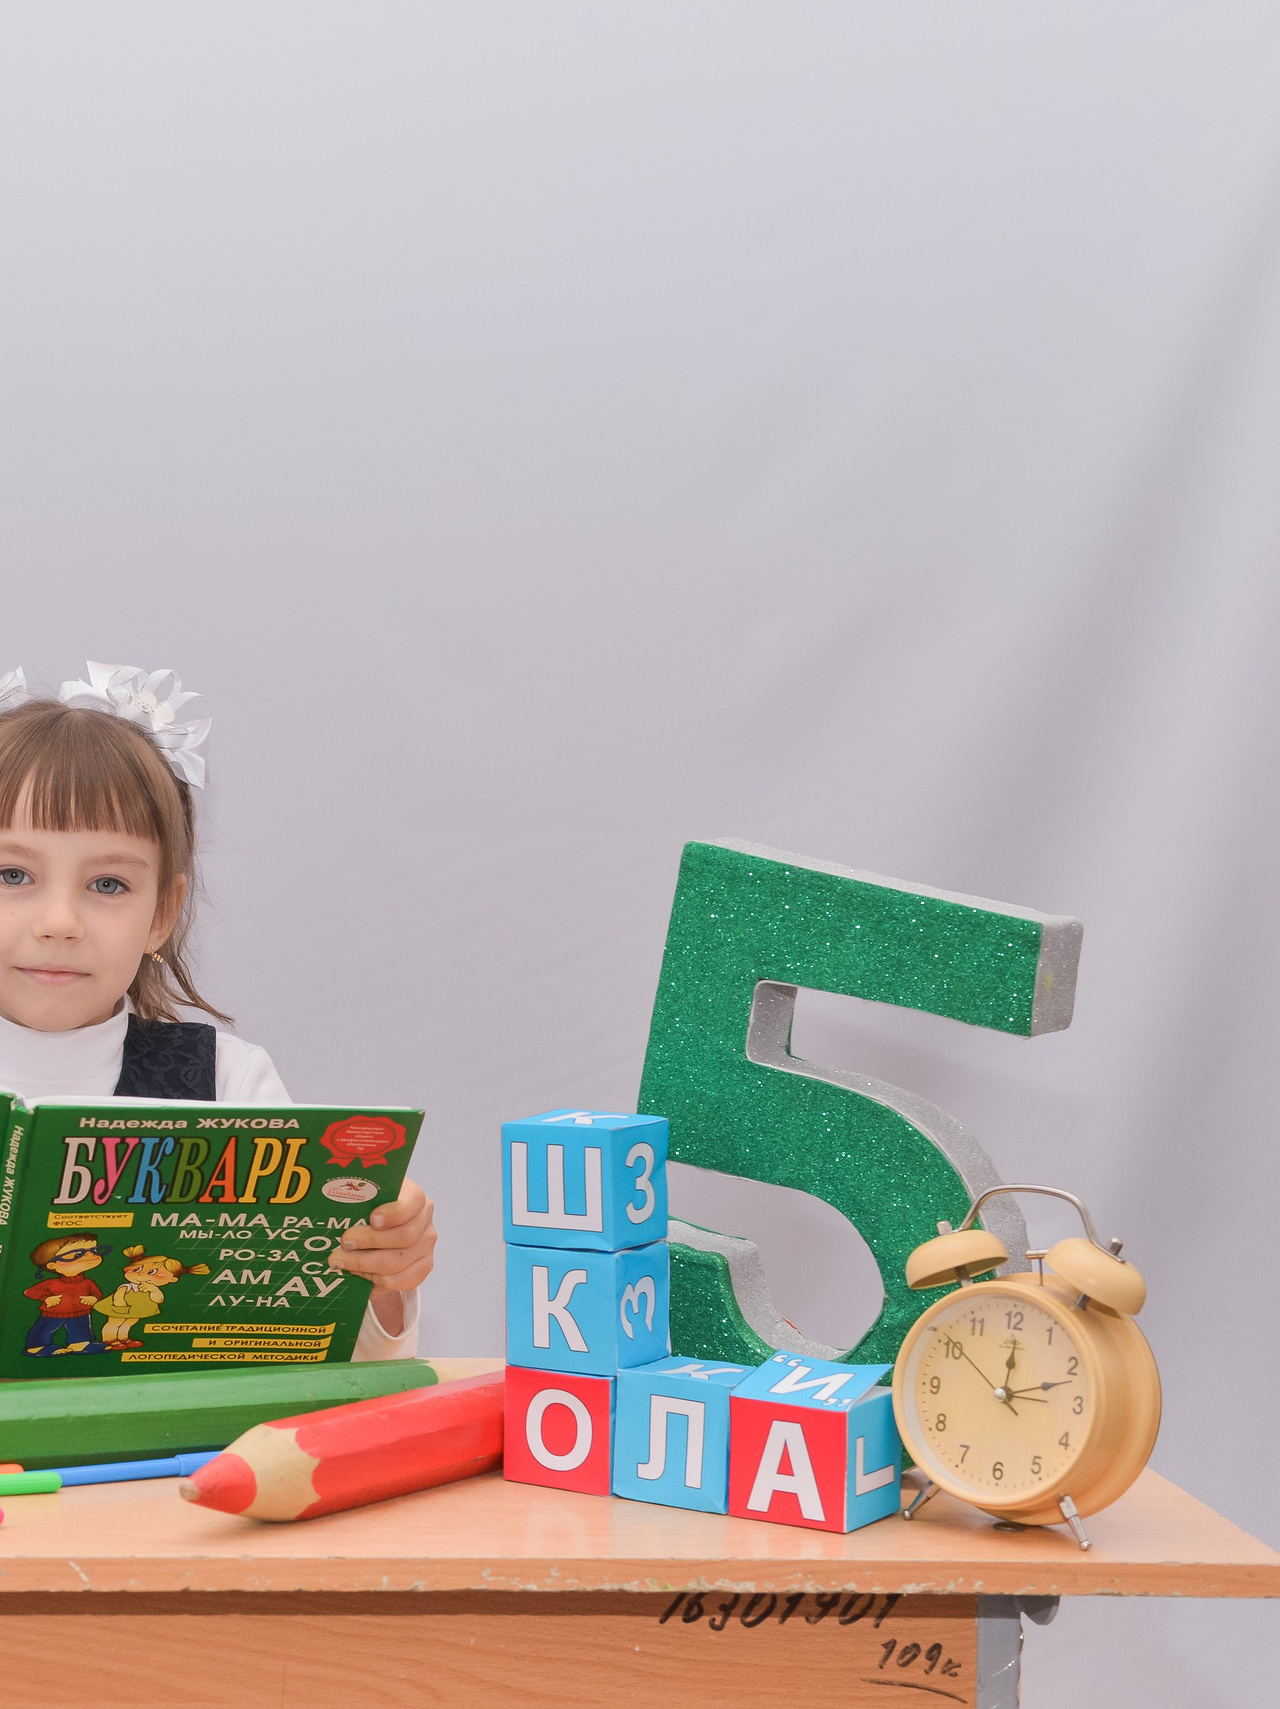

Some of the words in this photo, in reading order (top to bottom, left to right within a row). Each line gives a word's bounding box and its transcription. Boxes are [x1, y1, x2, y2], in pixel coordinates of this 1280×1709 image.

[79, 1116, 188, 1136] Надежда
[195, 1117, 300, 1135] ЖУКОВА
[637, 840, 1083, 1400] 5
[3, 1124, 25, 1176] Надежда
[52, 1136, 312, 1205] БУКВАРЬ
[510, 1141, 604, 1233] Ш
[150, 1212, 269, 1228] МА-МА
[179, 1229, 252, 1240] МЫ-ЛО
[265, 1228, 301, 1241] УС
[218, 1248, 301, 1263] РО-ЗА
[211, 1268, 272, 1285] АМ
[274, 1276, 345, 1298] АУ
[208, 1295, 291, 1309] ЛУ-НА
[532, 1265, 590, 1353] К
[151, 1324, 222, 1333] СОЧЕТАНИЕ
[225, 1324, 327, 1335] ТРАДИЦИОННОЙ
[969, 1317, 985, 1337] 11
[1005, 1310, 1024, 1331] 12
[223, 1339, 322, 1348] ОРИГИНАЛЬНОЙ
[1045, 1326, 1054, 1346] 1
[128, 1353, 246, 1361] ЛОГОПЕДИЧЕСКОЙ
[252, 1354, 319, 1362] МЕТОДИКИ
[943, 1341, 963, 1360] 10
[1066, 1356, 1079, 1376] 2
[929, 1376, 941, 1395] 9
[1072, 1396, 1084, 1415] 3
[934, 1413, 947, 1432] 8
[1058, 1431, 1070, 1451] 4
[525, 1388, 594, 1473] О
[637, 1394, 706, 1489] Л
[746, 1420, 826, 1522] А
[959, 1444, 971, 1464] 7
[991, 1461, 1004, 1480] 6
[1030, 1456, 1042, 1475] 5
